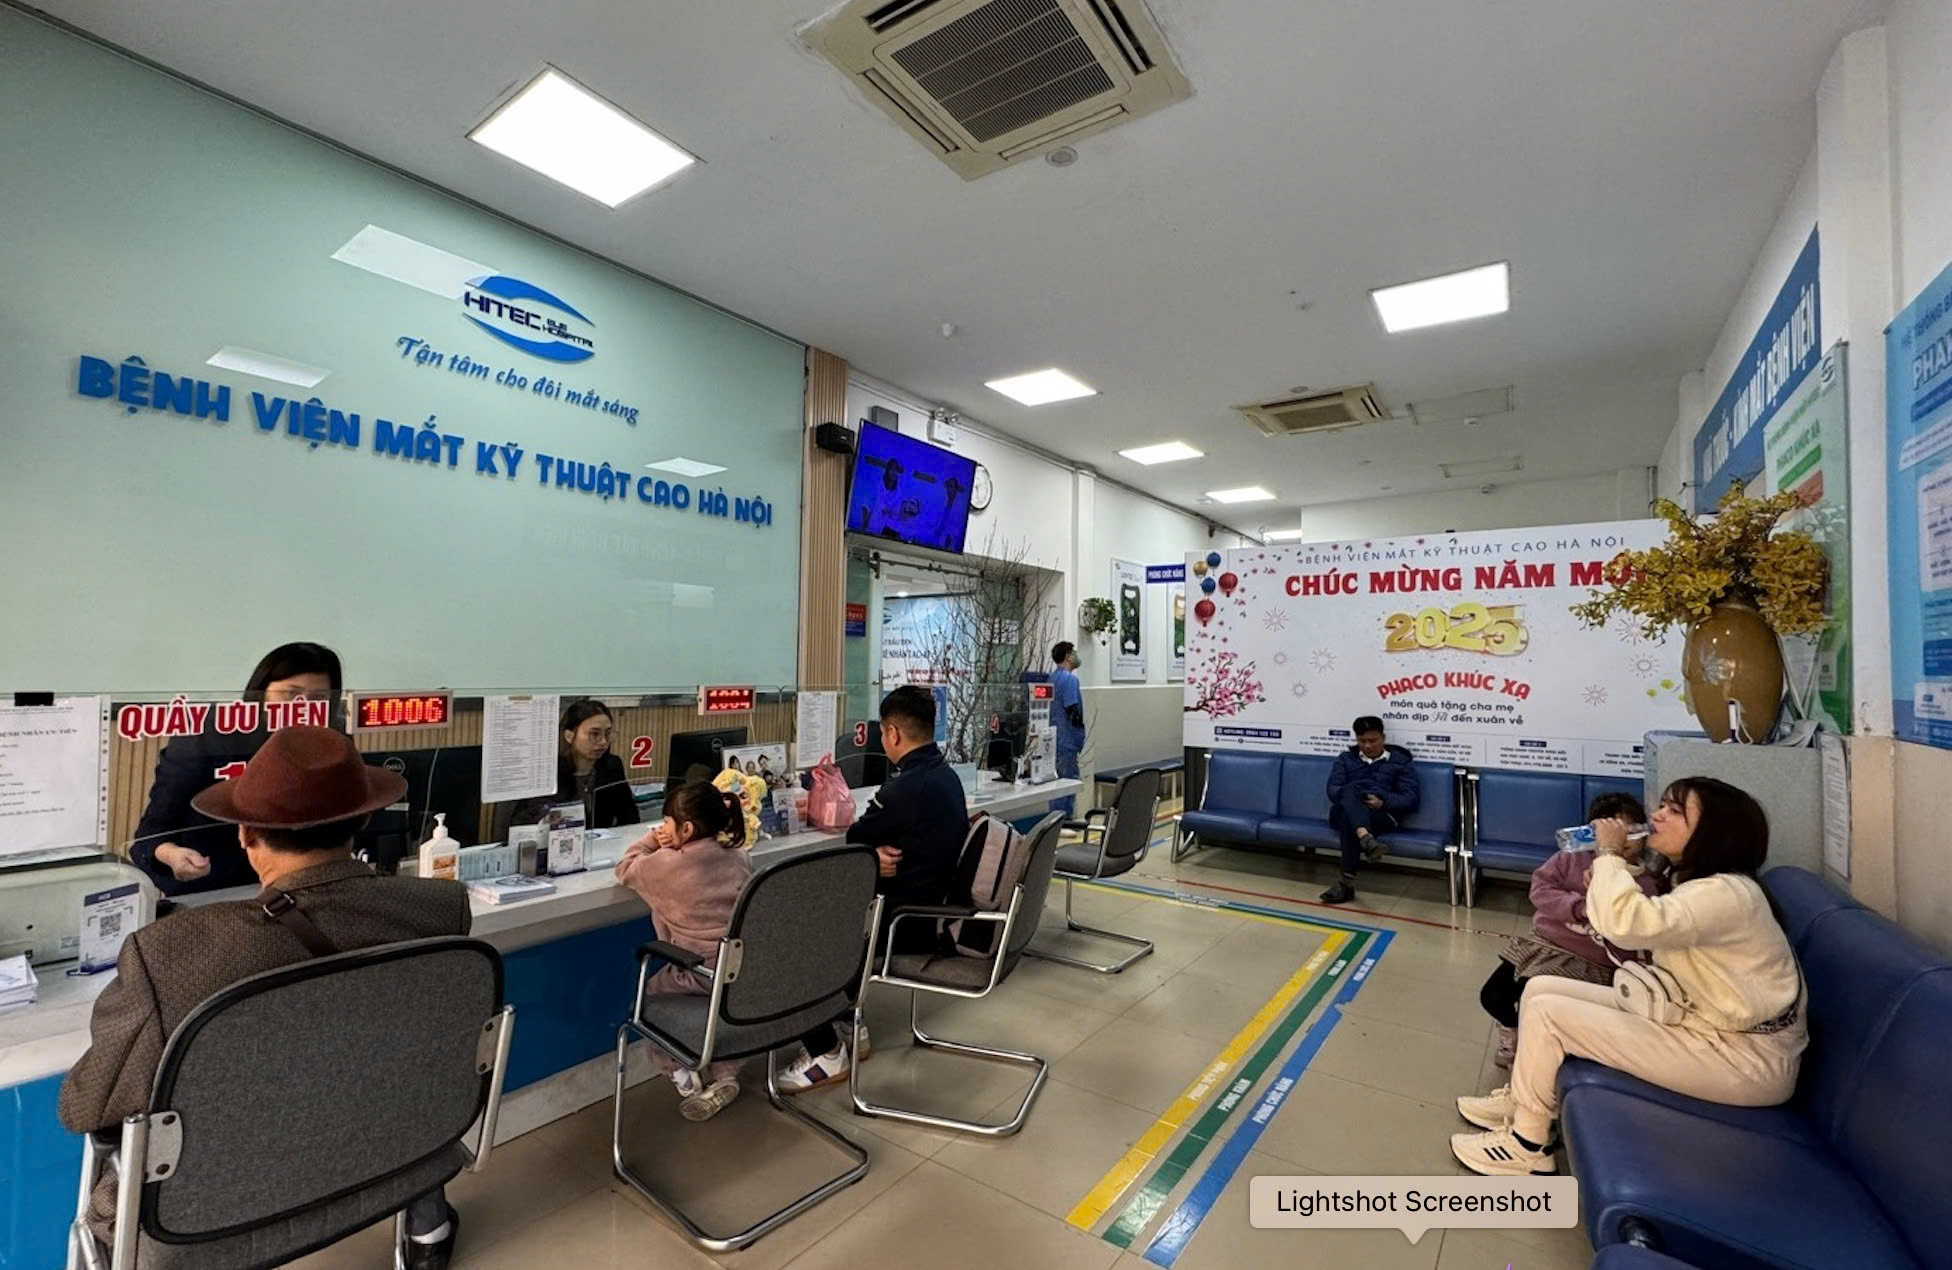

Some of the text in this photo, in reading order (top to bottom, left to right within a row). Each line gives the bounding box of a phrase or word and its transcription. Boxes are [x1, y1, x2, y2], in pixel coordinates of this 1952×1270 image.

[464, 291, 541, 330] HITEC
[542, 325, 593, 348] HOSPITAL
[1767, 321, 1791, 407] BỆNH
[1791, 283, 1815, 371] VIỆN
[398, 336, 640, 425] Tận tâm cho đôi mắt sáng
[78, 355, 772, 528] BỆNH VIỆN MẮT KỸ THUẬT CAO HÀ NỘI
[1306, 555, 1341, 565] BỆNH
[1348, 551, 1380, 563] VIỆN
[1386, 549, 1416, 560] MẮT
[1449, 543, 1502, 556] THUẬT
[1511, 541, 1547, 552] CAO
[1557, 539, 1580, 549] HÀ
[1591, 536, 1624, 549] NỘI
[1285, 567, 1358, 596] CHÚC
[1369, 564, 1462, 593] MỪNG
[1474, 559, 1555, 590] NĂM
[1384, 602, 1529, 657] 2025
[1376, 670, 1531, 702] PHACO KHÚC XẠ
[120, 696, 329, 740] QUẦY ƯU TIÊN
[362, 698, 443, 726] 1006
[1383, 711, 1408, 720] nhân
[1412, 713, 1429, 722] dịp
[1451, 712, 1472, 722] đến
[1477, 715, 1505, 724] xuân
[1509, 714, 1524, 725] về
[1390, 699, 1514, 714] món quà tặng cha mẹ
[854, 721, 868, 747] 3
[630, 736, 653, 768] 2
